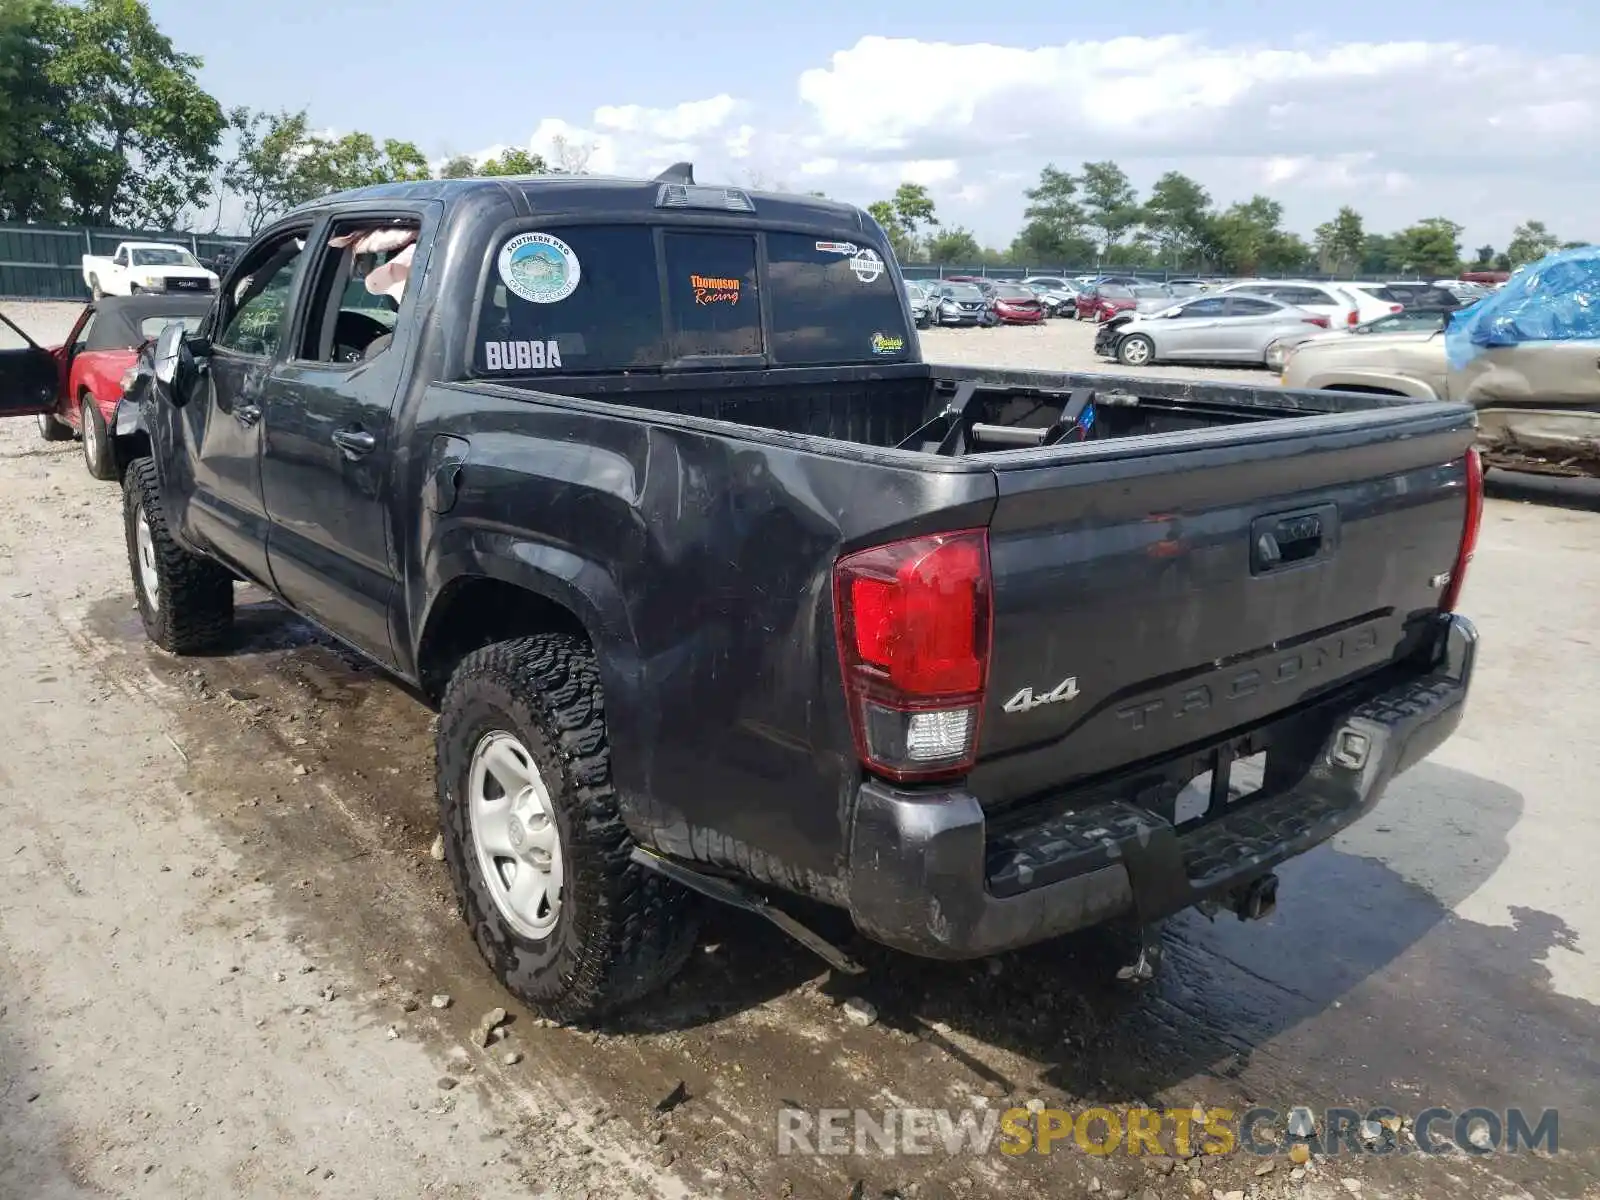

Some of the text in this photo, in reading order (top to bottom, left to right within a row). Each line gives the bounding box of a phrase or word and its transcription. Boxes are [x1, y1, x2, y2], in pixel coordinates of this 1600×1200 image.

[506, 235, 570, 256] SOUTHERN PRO
[690, 274, 740, 291] Thompson
[693, 288, 739, 306] Racing
[485, 340, 562, 370] BUBBA
